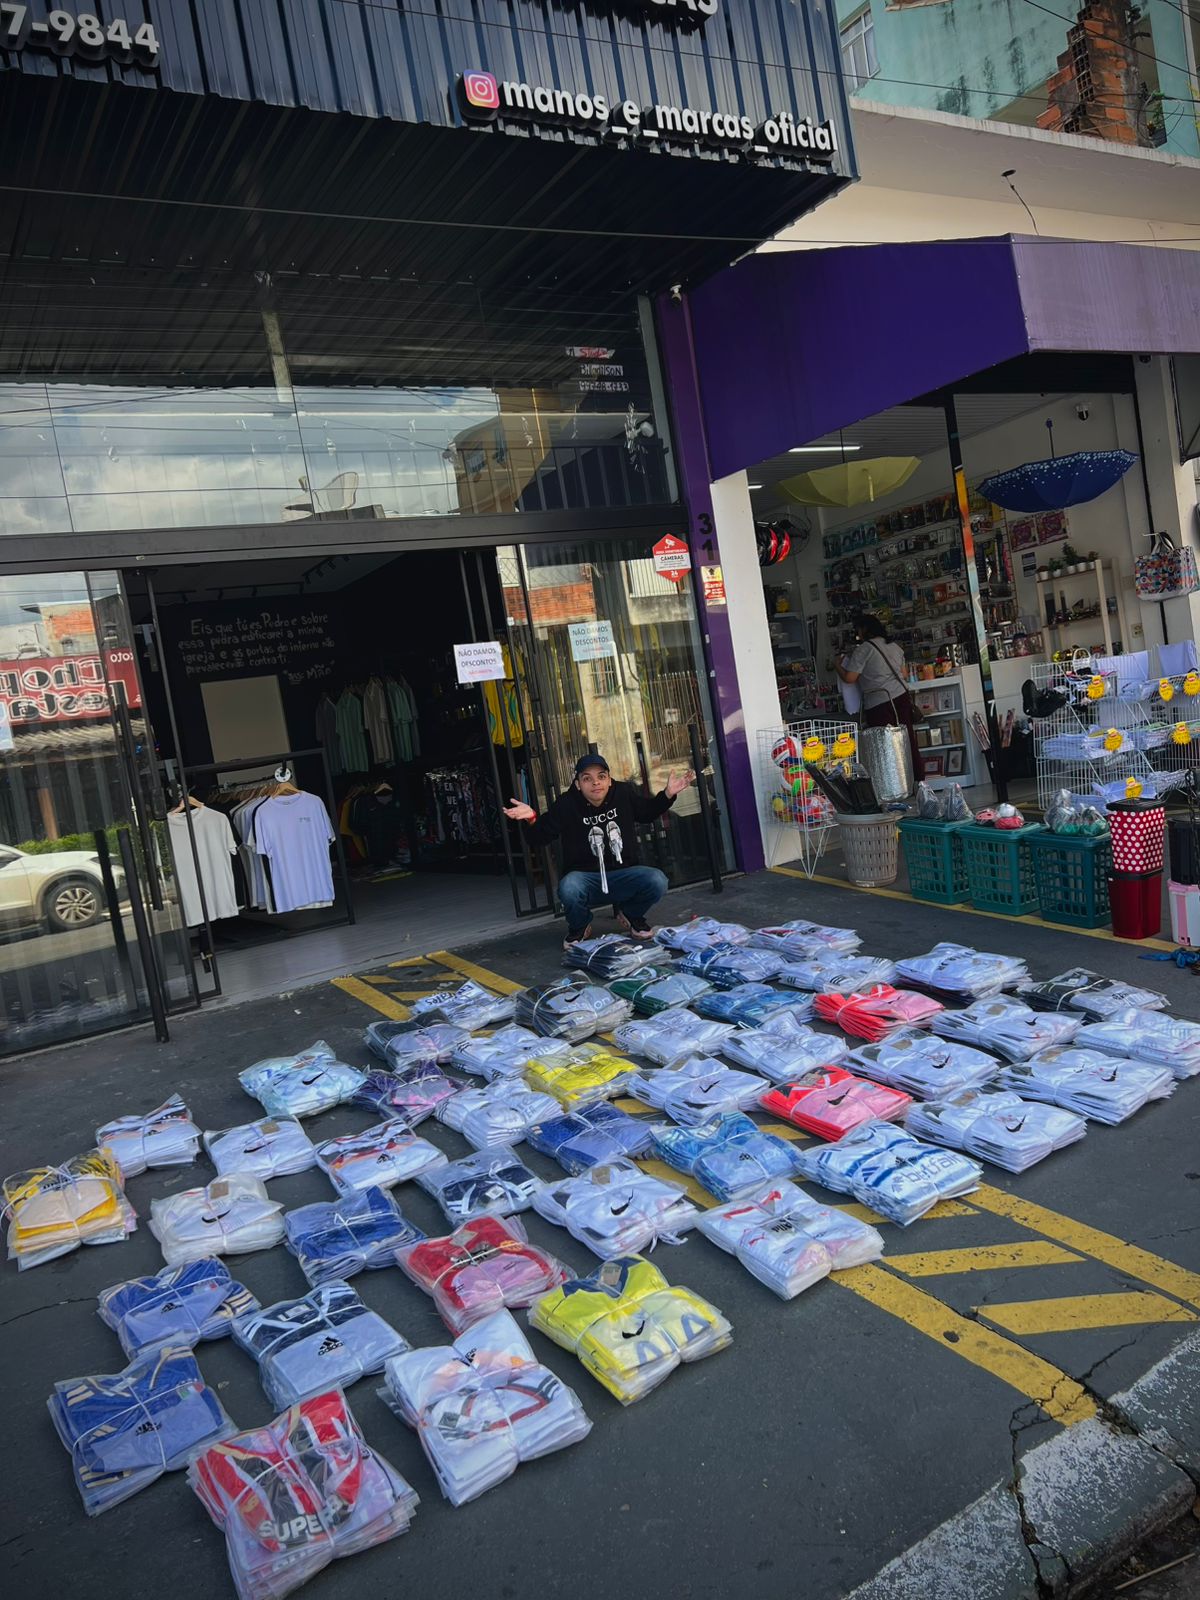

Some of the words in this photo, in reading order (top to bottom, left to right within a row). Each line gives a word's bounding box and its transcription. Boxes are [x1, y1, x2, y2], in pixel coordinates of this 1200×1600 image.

[502, 81, 838, 153] manos_e_marcas_oficial
[191, 618, 213, 635] Eis
[215, 623, 233, 637] que
[572, 628, 586, 636] NÃO
[575, 636, 609, 646] DESCONTOS
[458, 648, 472, 657] NÃO
[473, 647, 496, 656] DAMOS
[461, 658, 497, 668] DESCONTOS
[583, 807, 618, 826] GUCCI
